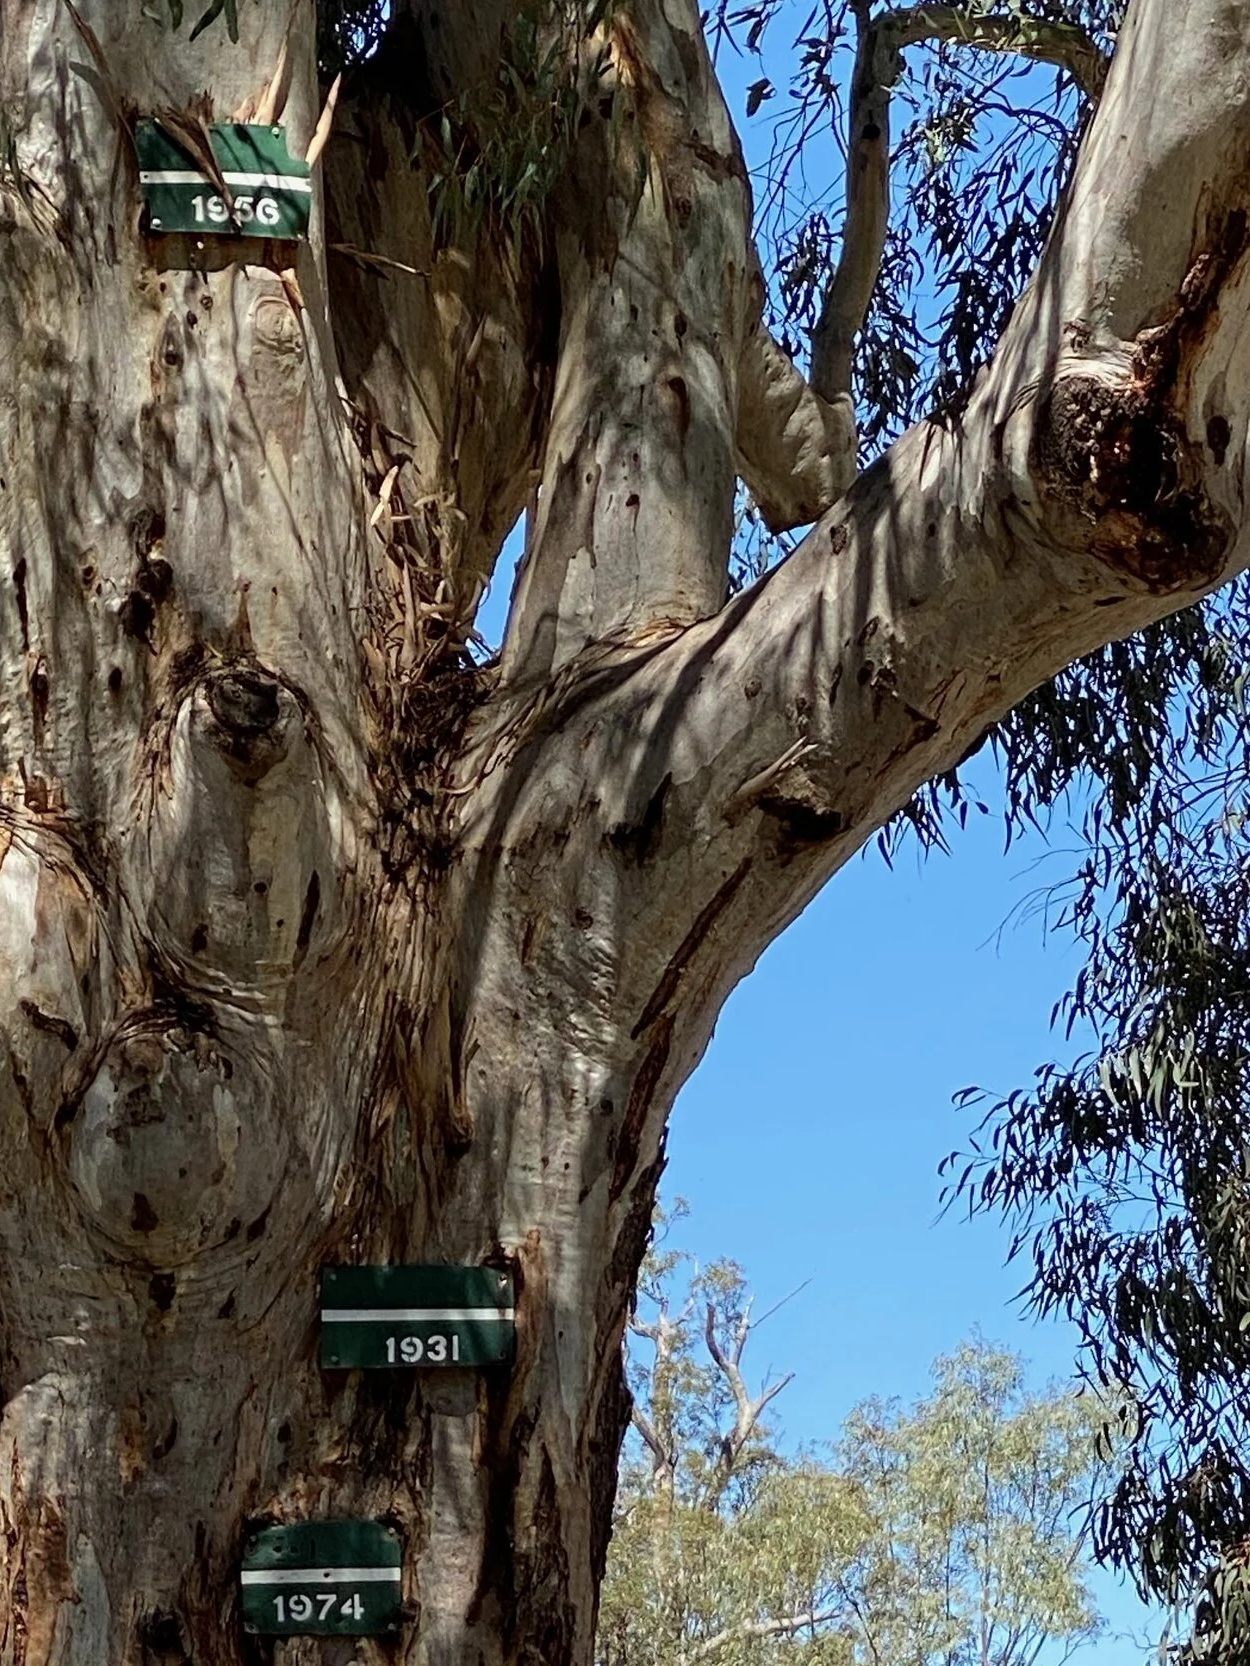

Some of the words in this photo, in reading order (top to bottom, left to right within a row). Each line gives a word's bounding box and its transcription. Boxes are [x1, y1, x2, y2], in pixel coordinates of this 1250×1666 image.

[190, 194, 281, 226] 1956
[385, 1334, 460, 1364] 1931
[272, 1593, 365, 1623] 1974
